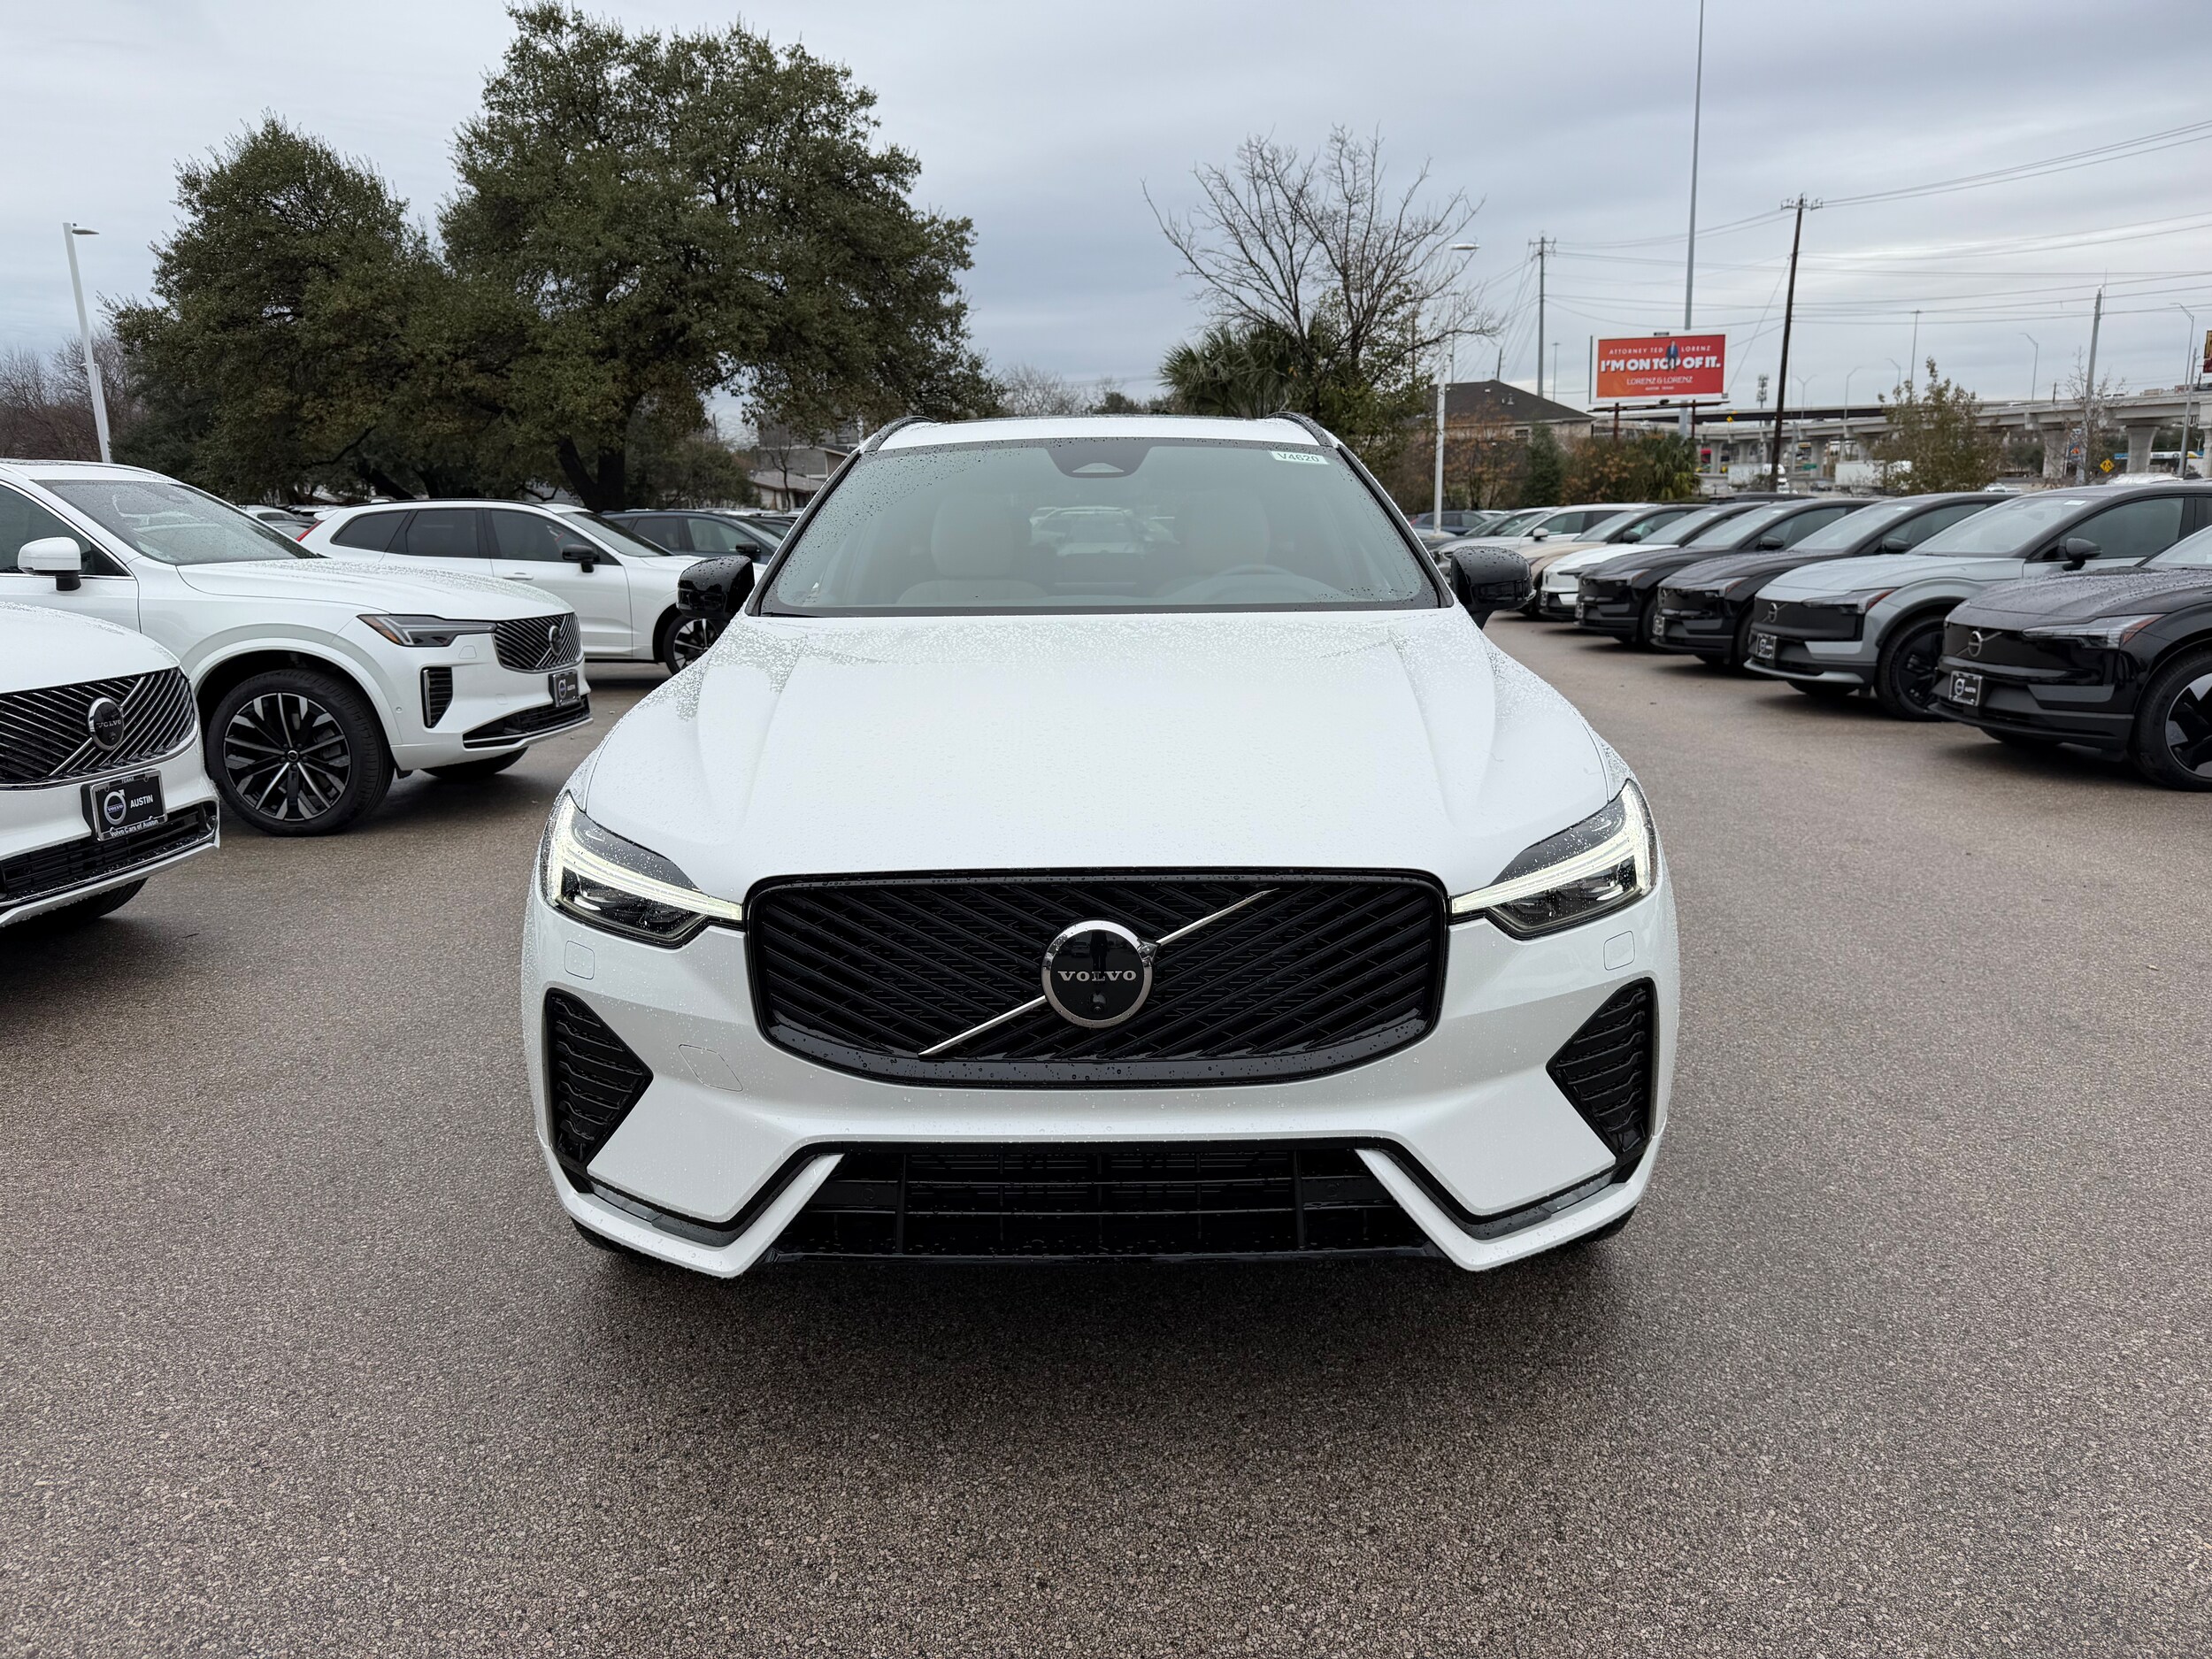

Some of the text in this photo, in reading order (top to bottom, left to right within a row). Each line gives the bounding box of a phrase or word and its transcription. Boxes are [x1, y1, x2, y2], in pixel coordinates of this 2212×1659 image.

[1601, 358, 1625, 373] I'M
[1626, 357, 1651, 372] ON
[1682, 356, 1704, 370] OF
[1705, 355, 1721, 369] IT.
[1663, 375, 1693, 384] LORENZ
[1277, 452, 1320, 463] V4620
[130, 794, 154, 809] AUSTIN
[109, 828, 125, 837] Volvo
[142, 819, 159, 828] Austin
[1057, 970, 1137, 982] VOLVO
